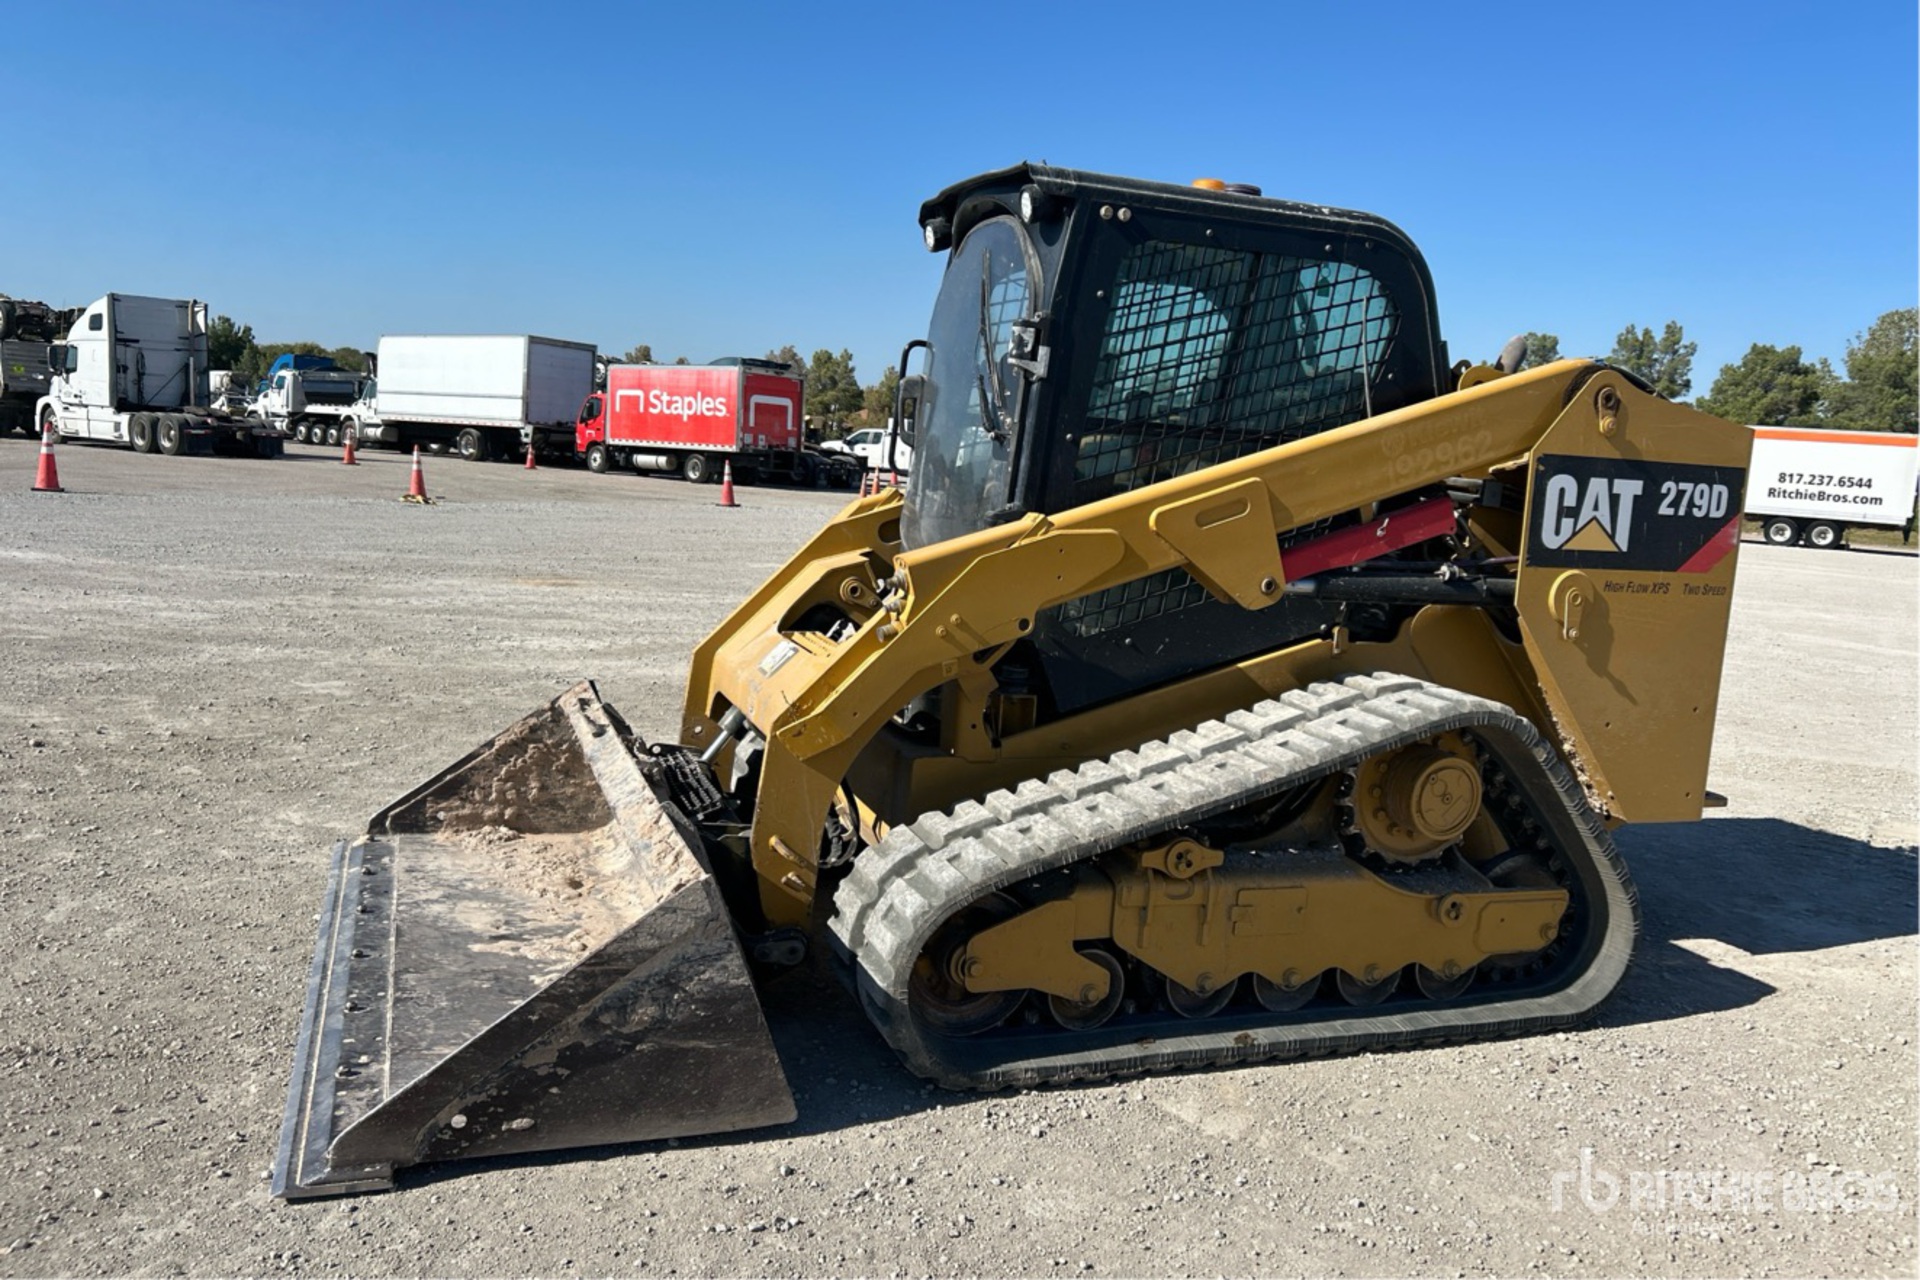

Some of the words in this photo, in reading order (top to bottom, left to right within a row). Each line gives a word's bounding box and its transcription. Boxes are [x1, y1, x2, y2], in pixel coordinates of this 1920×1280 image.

[648, 389, 728, 422] Staples
[1777, 472, 1873, 489] 817.237.6544
[1767, 487, 1884, 506] RitchieBros.com
[1541, 473, 1644, 552] CAT
[1657, 480, 1729, 519] 279D
[1649, 582, 1672, 595] XPS
